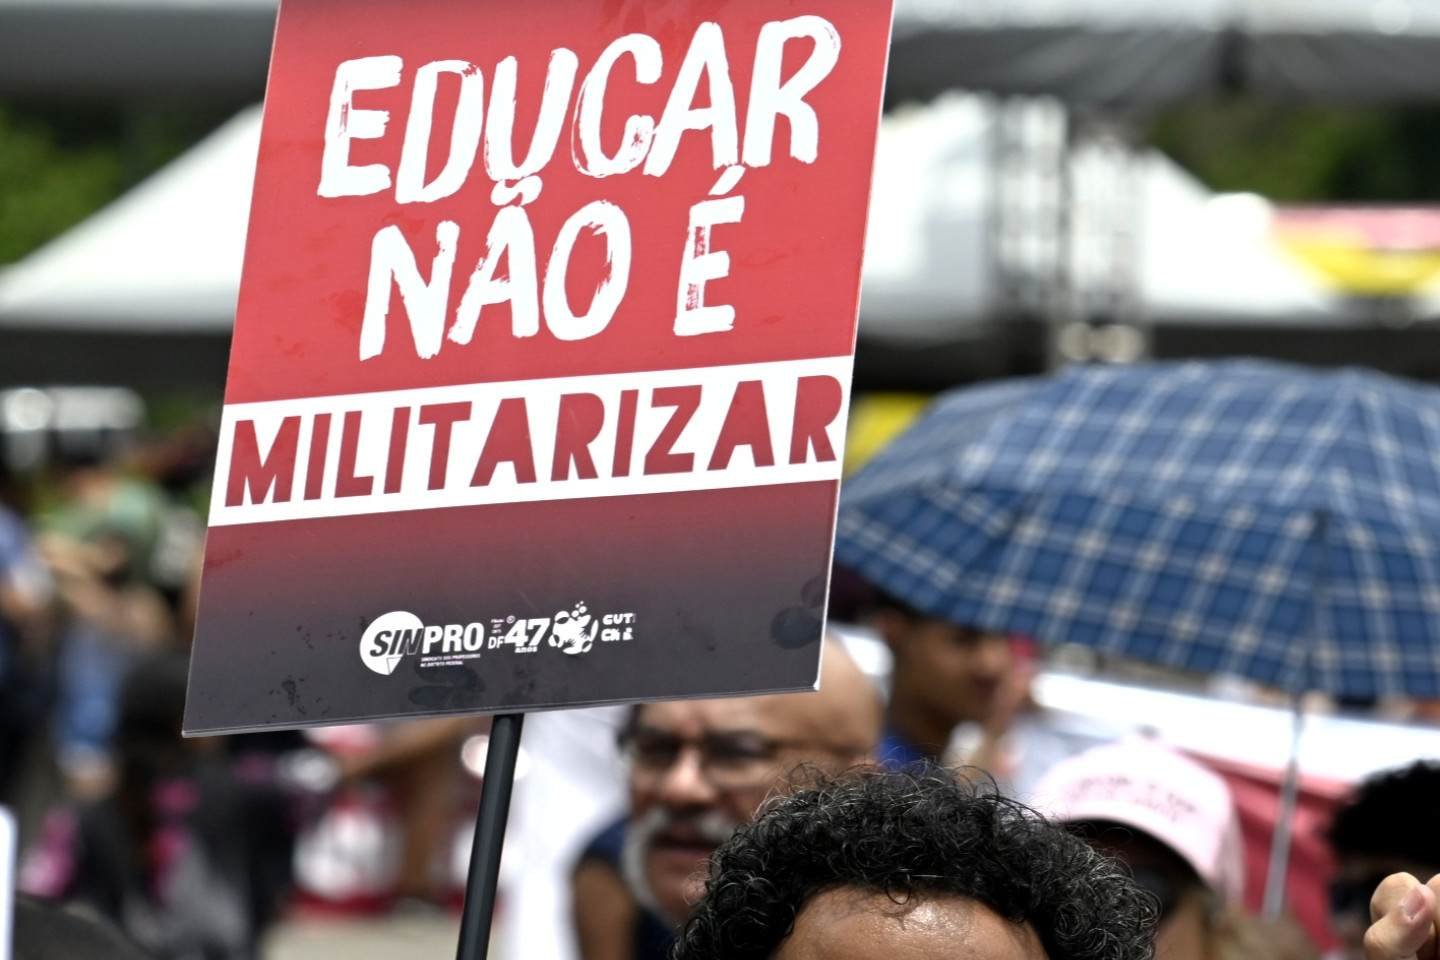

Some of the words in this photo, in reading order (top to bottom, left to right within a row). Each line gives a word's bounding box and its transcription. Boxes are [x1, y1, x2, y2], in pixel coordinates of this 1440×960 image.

[317, 15, 841, 204] EDUCAR
[359, 176, 632, 361] NÃO
[673, 165, 745, 337] É
[224, 375, 844, 507] MILITARIZAR
[503, 618, 550, 647] 47
